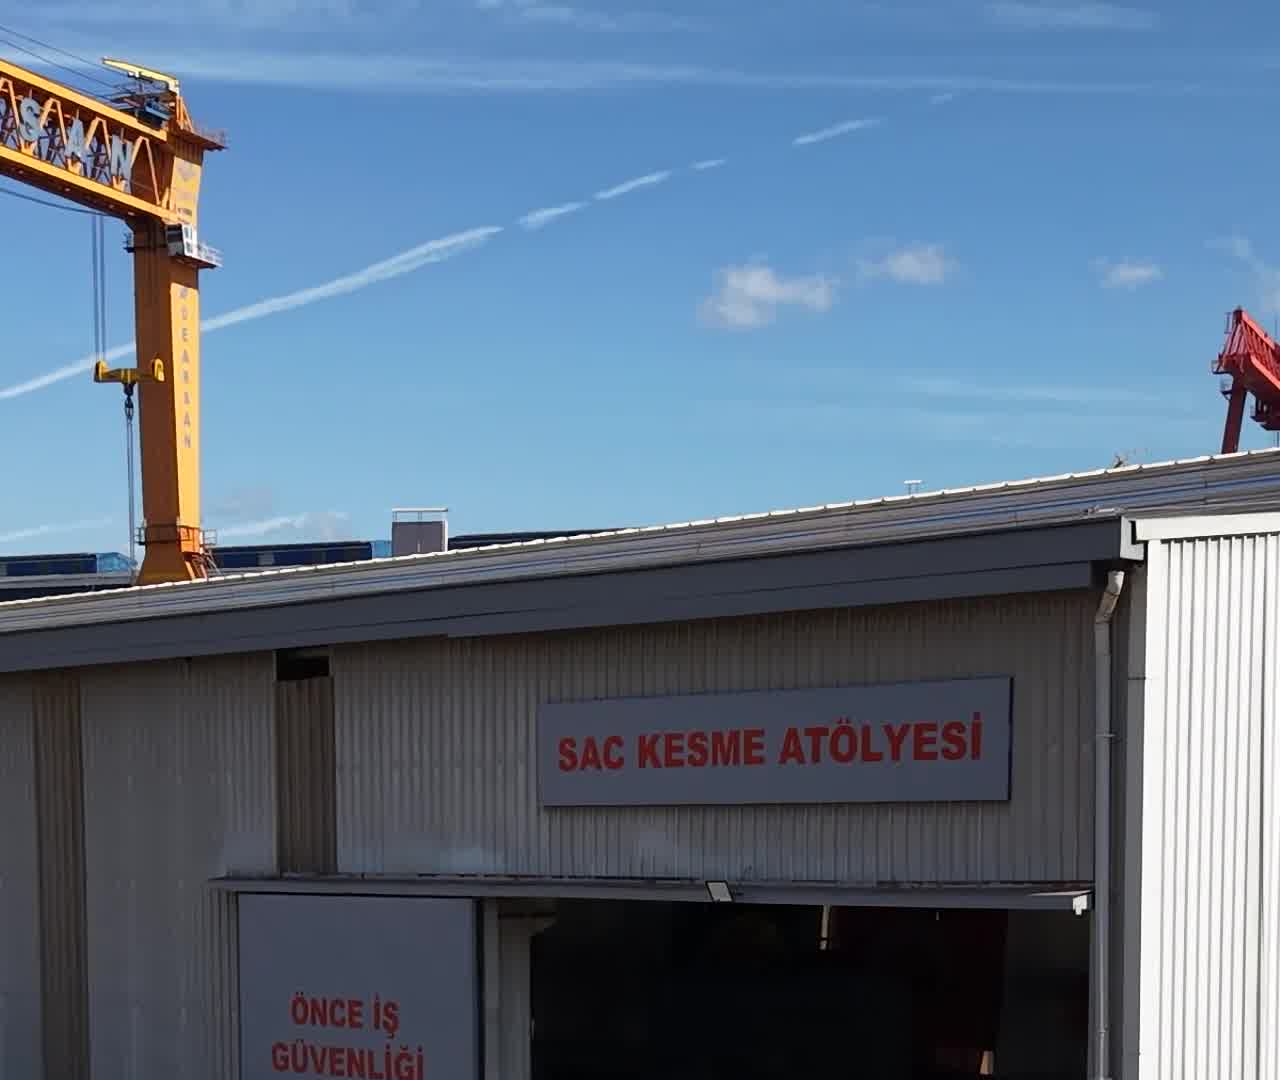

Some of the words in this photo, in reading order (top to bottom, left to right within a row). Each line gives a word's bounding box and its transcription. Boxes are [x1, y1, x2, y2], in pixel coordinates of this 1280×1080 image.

[558, 734, 625, 772] SAC
[637, 727, 766, 769] KESME
[778, 711, 983, 766] ATÖLYESİ
[290, 992, 363, 1030] ÖNCE
[372, 993, 400, 1039] İŞ
